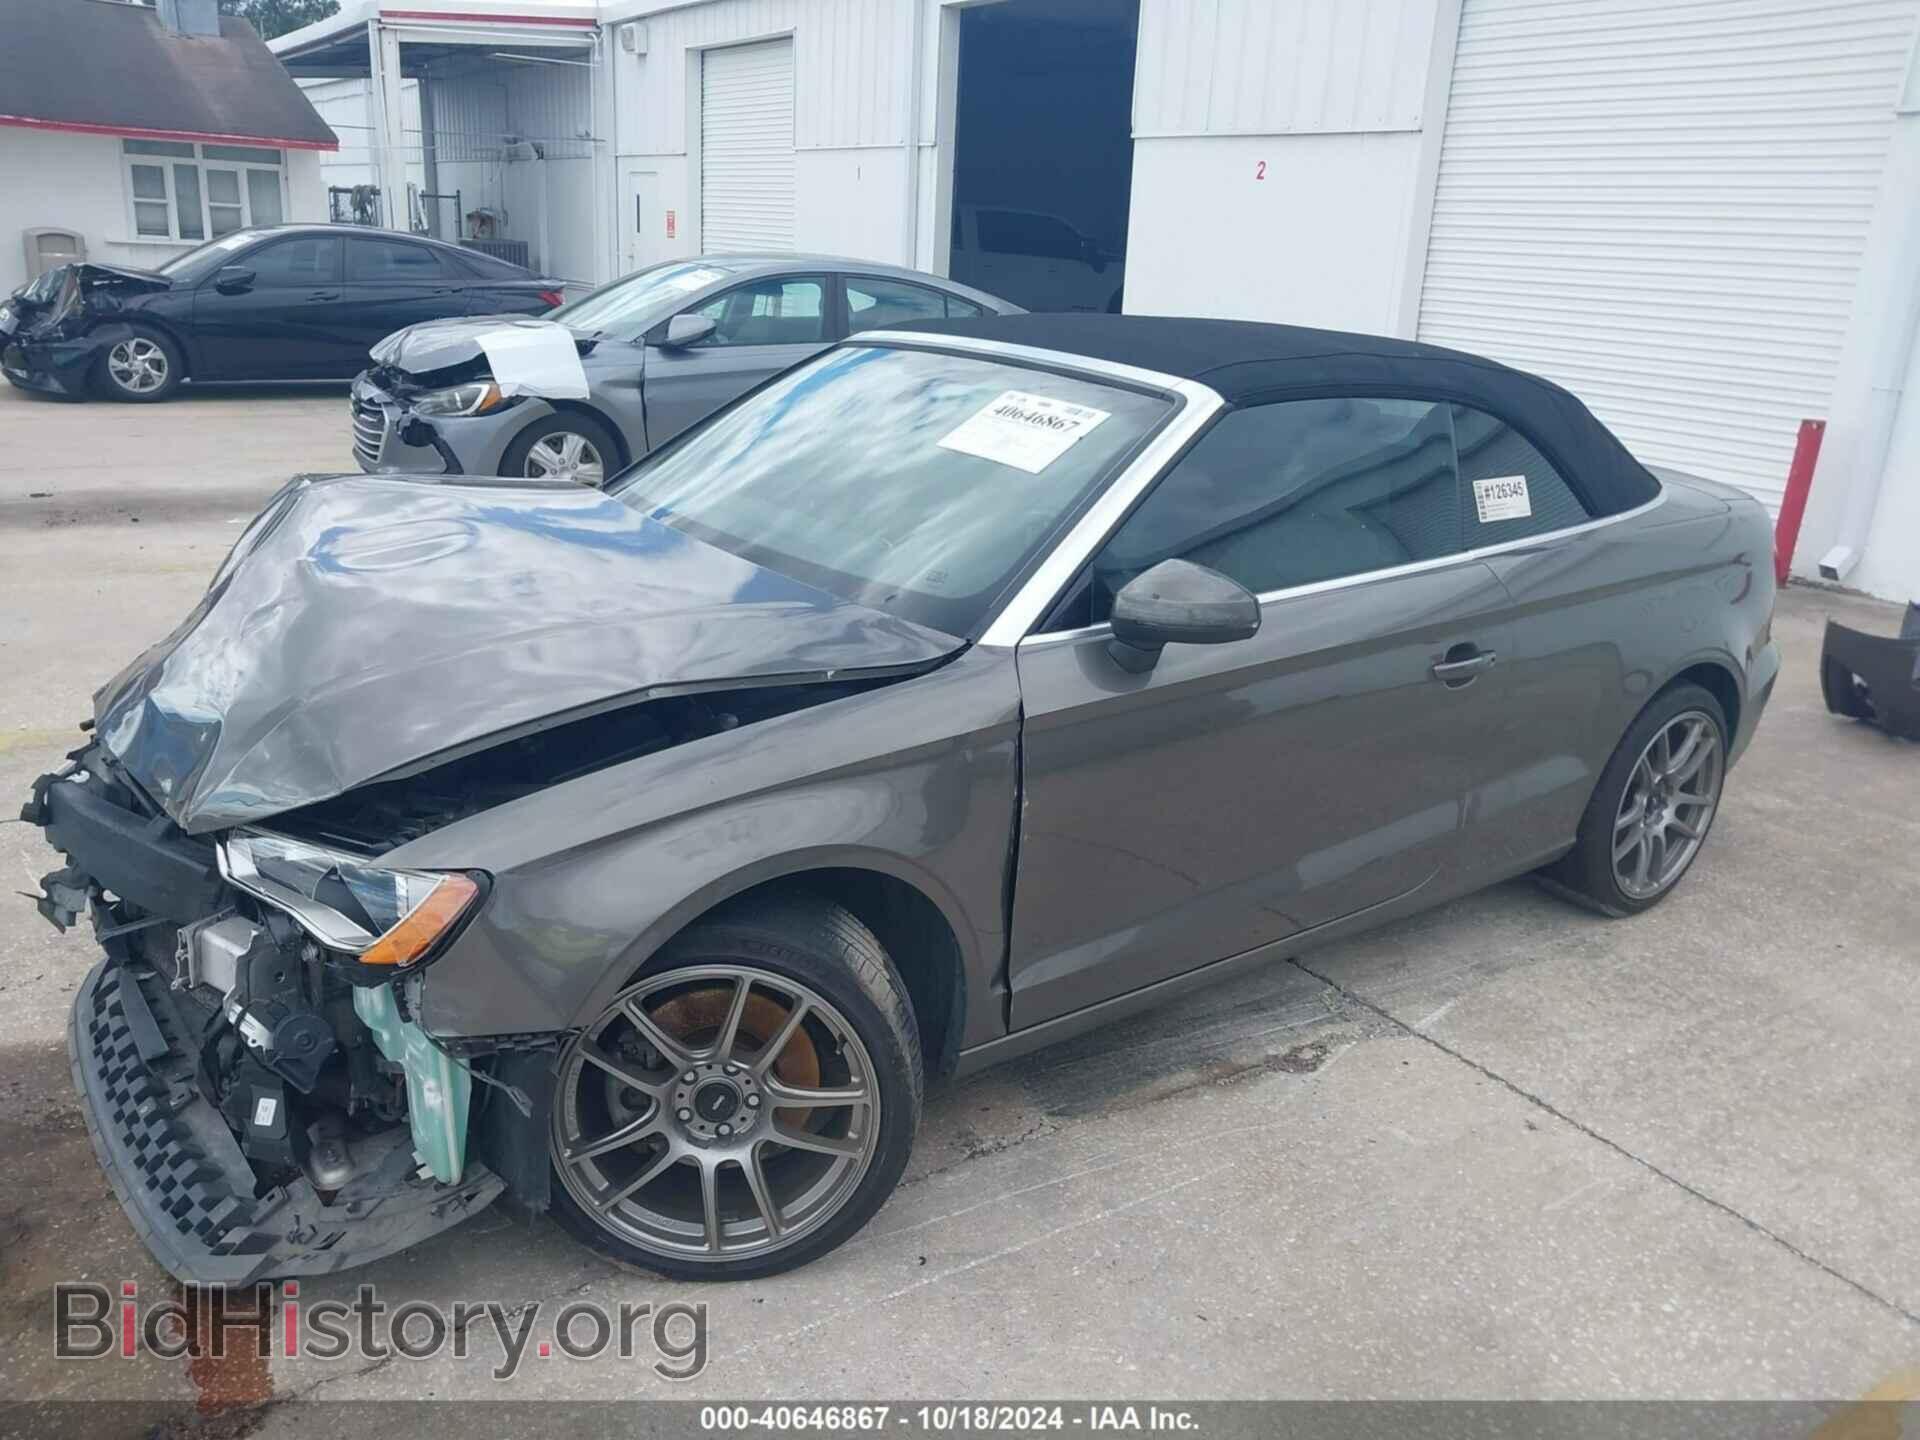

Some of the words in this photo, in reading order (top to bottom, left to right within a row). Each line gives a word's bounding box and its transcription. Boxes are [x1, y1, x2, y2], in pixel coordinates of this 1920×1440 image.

[1256, 160, 1266, 180] 2
[994, 405, 1080, 432] 40646867
[1484, 480, 1524, 501] #126345
